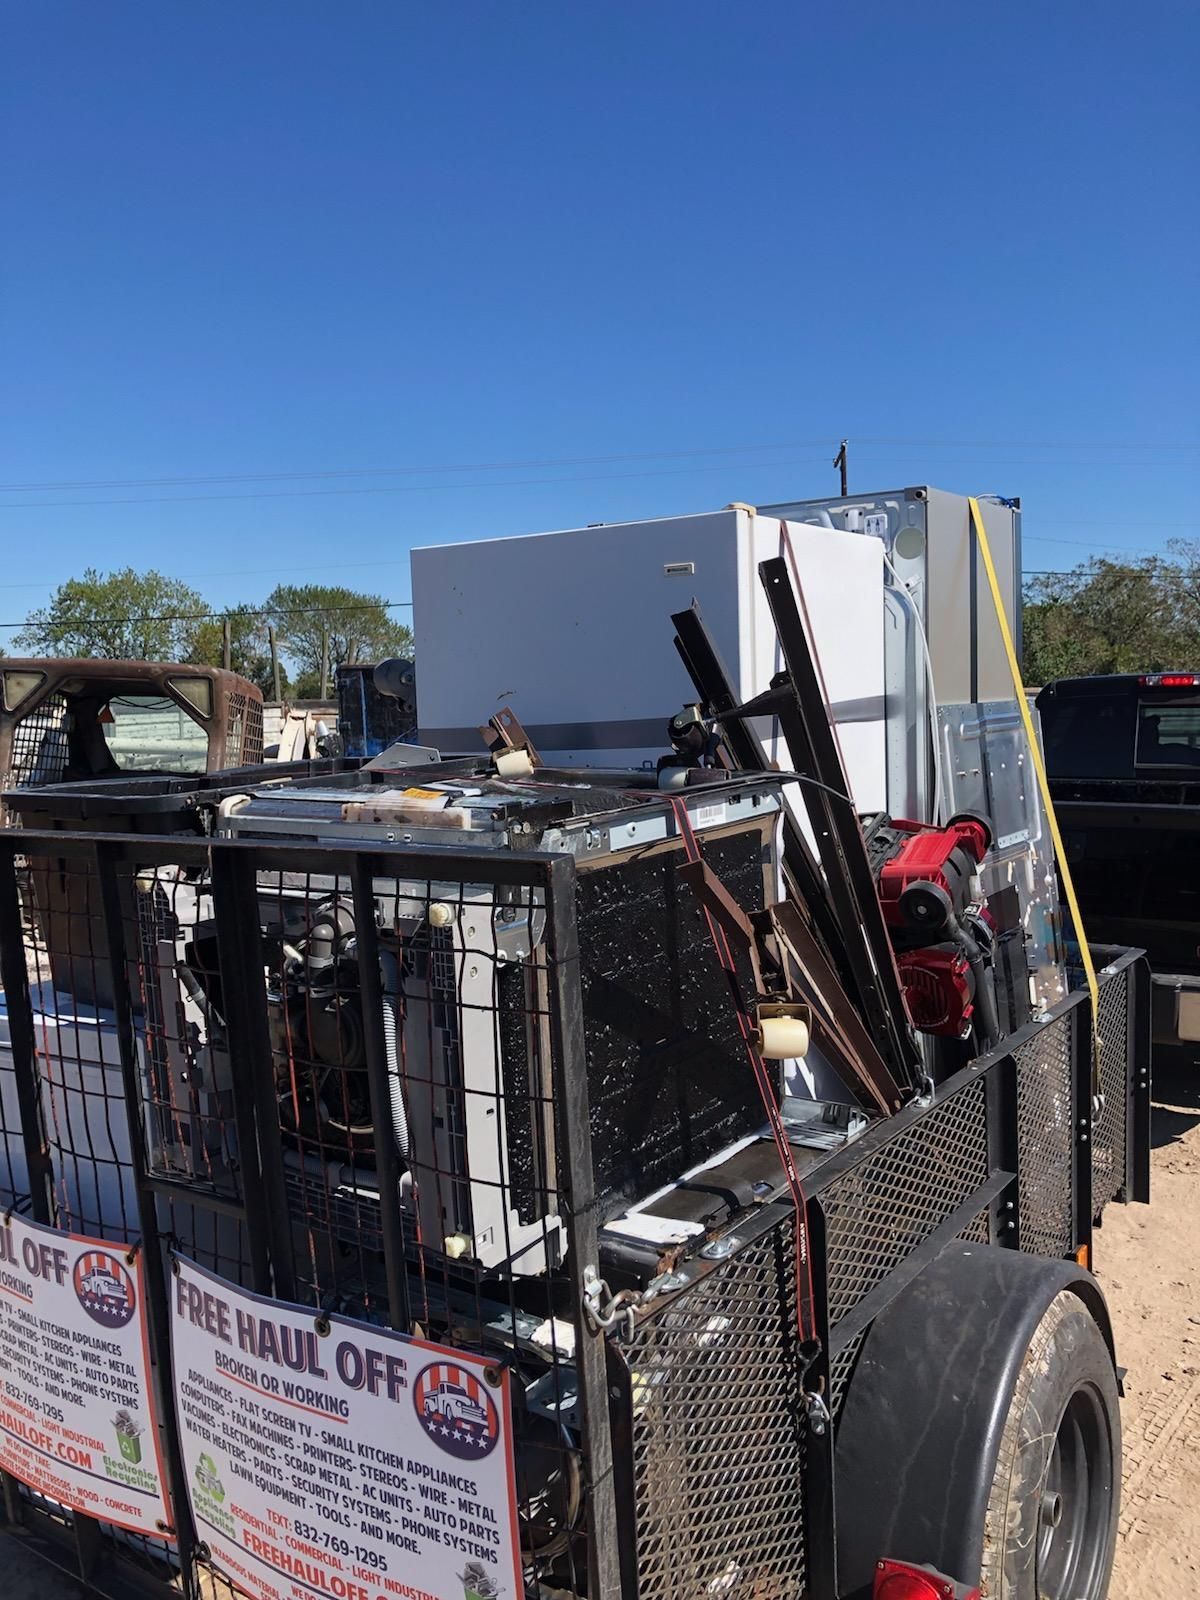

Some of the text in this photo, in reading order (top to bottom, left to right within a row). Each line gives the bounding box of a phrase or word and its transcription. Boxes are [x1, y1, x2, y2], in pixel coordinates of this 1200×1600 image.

[0, 1270, 33, 1298] ORKING
[22, 1237, 69, 1286] OFF
[5, 1301, 12, 1314] TV
[18, 1309, 38, 1327] SMALL
[39, 1319, 70, 1340] KITCHEN
[72, 1331, 122, 1357] APPLIANCES
[42, 1336, 74, 1357] STEREOS
[81, 1349, 101, 1366] WIRE
[109, 1359, 136, 1377] METAL
[177, 1277, 407, 1403] FREE HAUL OFF
[2, 1344, 139, 1410] SECURITY SYSTEMS PHONE SYSTEMS
[18, 1337, 38, 1358] METAL
[55, 1356, 78, 1374] UNITS
[86, 1367, 108, 1384] AUTO
[111, 1375, 139, 1394] PARTS
[18, 1367, 39, 1387] TOOLS
[45, 1382, 59, 1397] AND
[61, 1389, 86, 1408] MORE.
[215, 1350, 349, 1417] BROKEN OR WORKING
[6, 1381, 64, 1422] 832-769-1295
[42, 1418, 60, 1434] LIGHT
[62, 1428, 106, 1453] INDUSTRIAL
[181, 1381, 225, 1417] COMPUTERS
[232, 1409, 248, 1430] FAX
[249, 1419, 294, 1450] MACHINES
[359, 1462, 409, 1492] STEREOS
[418, 1483, 448, 1506] WIRE
[458, 1498, 498, 1524] METAL
[188, 1368, 478, 1496] APPLIANCES FLAT SCREEN TV SMALL KITCHEN APPLIANCES
[103, 1455, 157, 1481] Electronics
[105, 1466, 157, 1493] Recycling
[185, 1417, 498, 1564] WATER HEATERS PARTS SECURITY SYSTEMS PHONE SYSTEMS
[222, 1421, 276, 1461] ELECTRONICS
[284, 1453, 317, 1476] SCRAP
[318, 1467, 353, 1491] METAL
[362, 1484, 377, 1500] AC
[379, 1489, 413, 1513] UNITS
[424, 1506, 457, 1529] AUTO
[459, 1518, 500, 1545] PARTS
[77, 1486, 99, 1503] WOOD
[105, 1497, 142, 1517] CONCRETE
[229, 1460, 421, 1555] LAWN EQUIPMENT TOOLS AND MORE.
[230, 1503, 278, 1540] RESIDENTIAL
[285, 1535, 344, 1572] COMMERCIAL
[352, 1565, 381, 1587] LIGHT
[266, 1508, 388, 1571] TEXT: 832-769-1295
